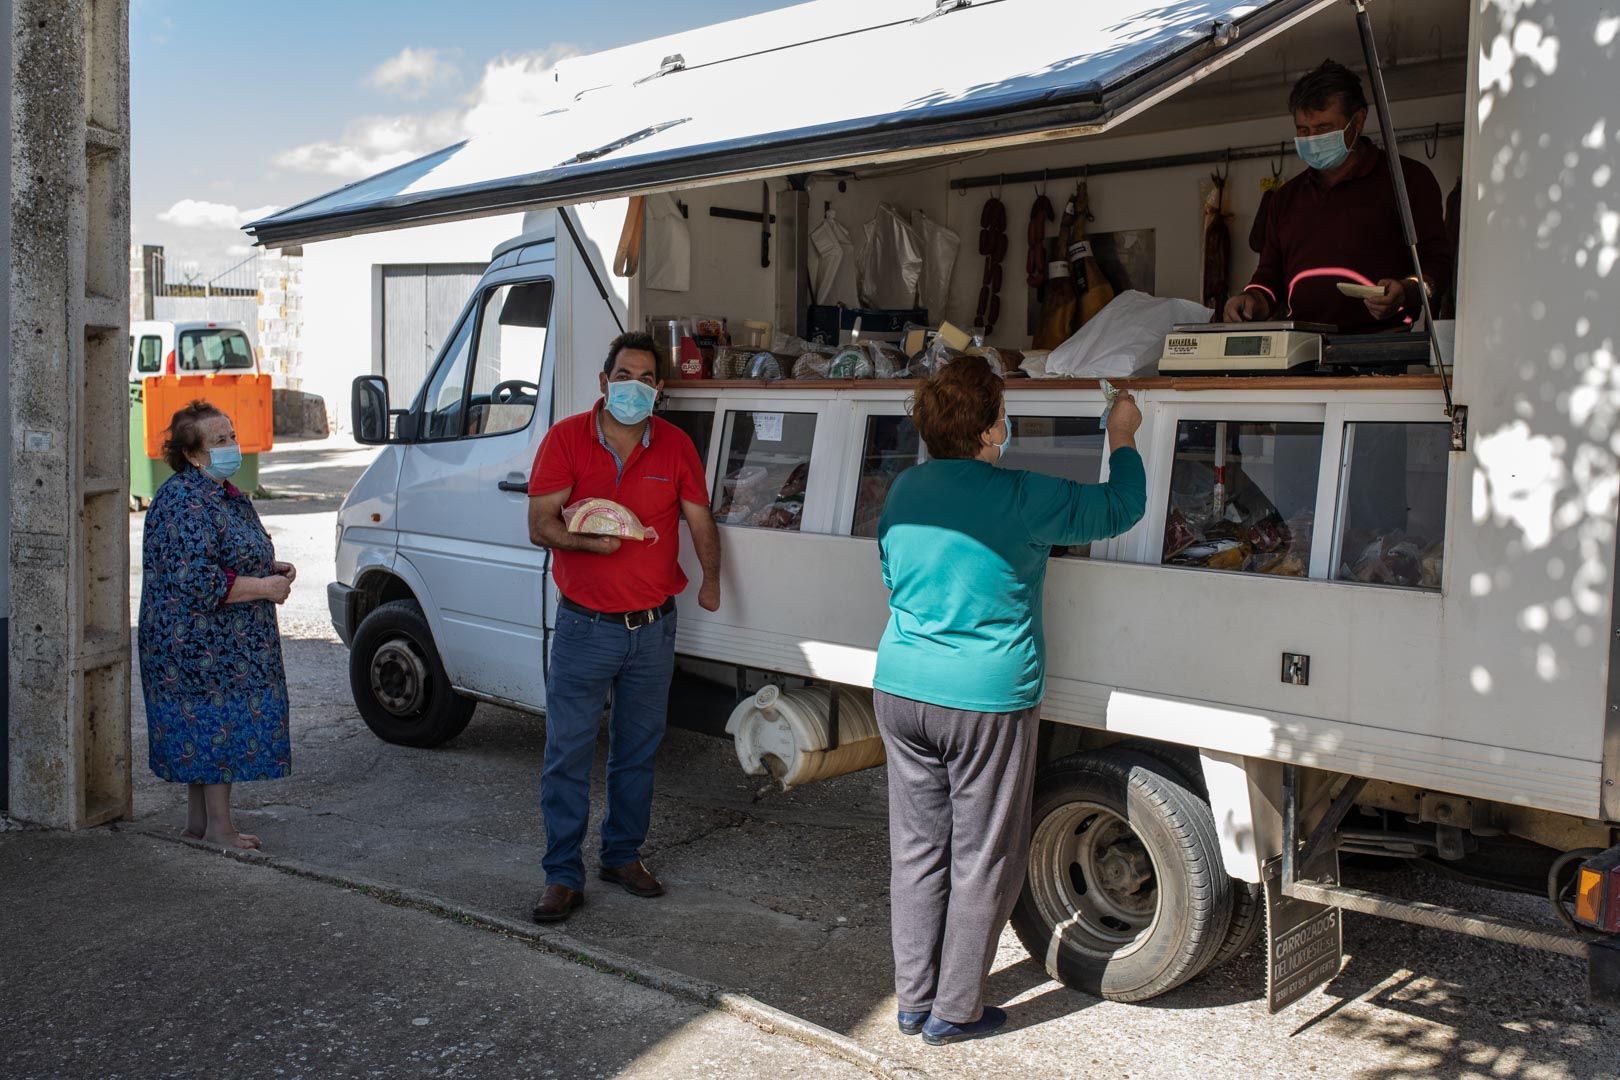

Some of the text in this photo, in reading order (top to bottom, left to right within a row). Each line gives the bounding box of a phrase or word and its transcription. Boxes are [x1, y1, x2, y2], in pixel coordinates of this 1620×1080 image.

[1274, 959, 1289, 981] DEL
[1289, 937, 1326, 972] NOROESTE
[1276, 912, 1336, 960] CARROZADOS
